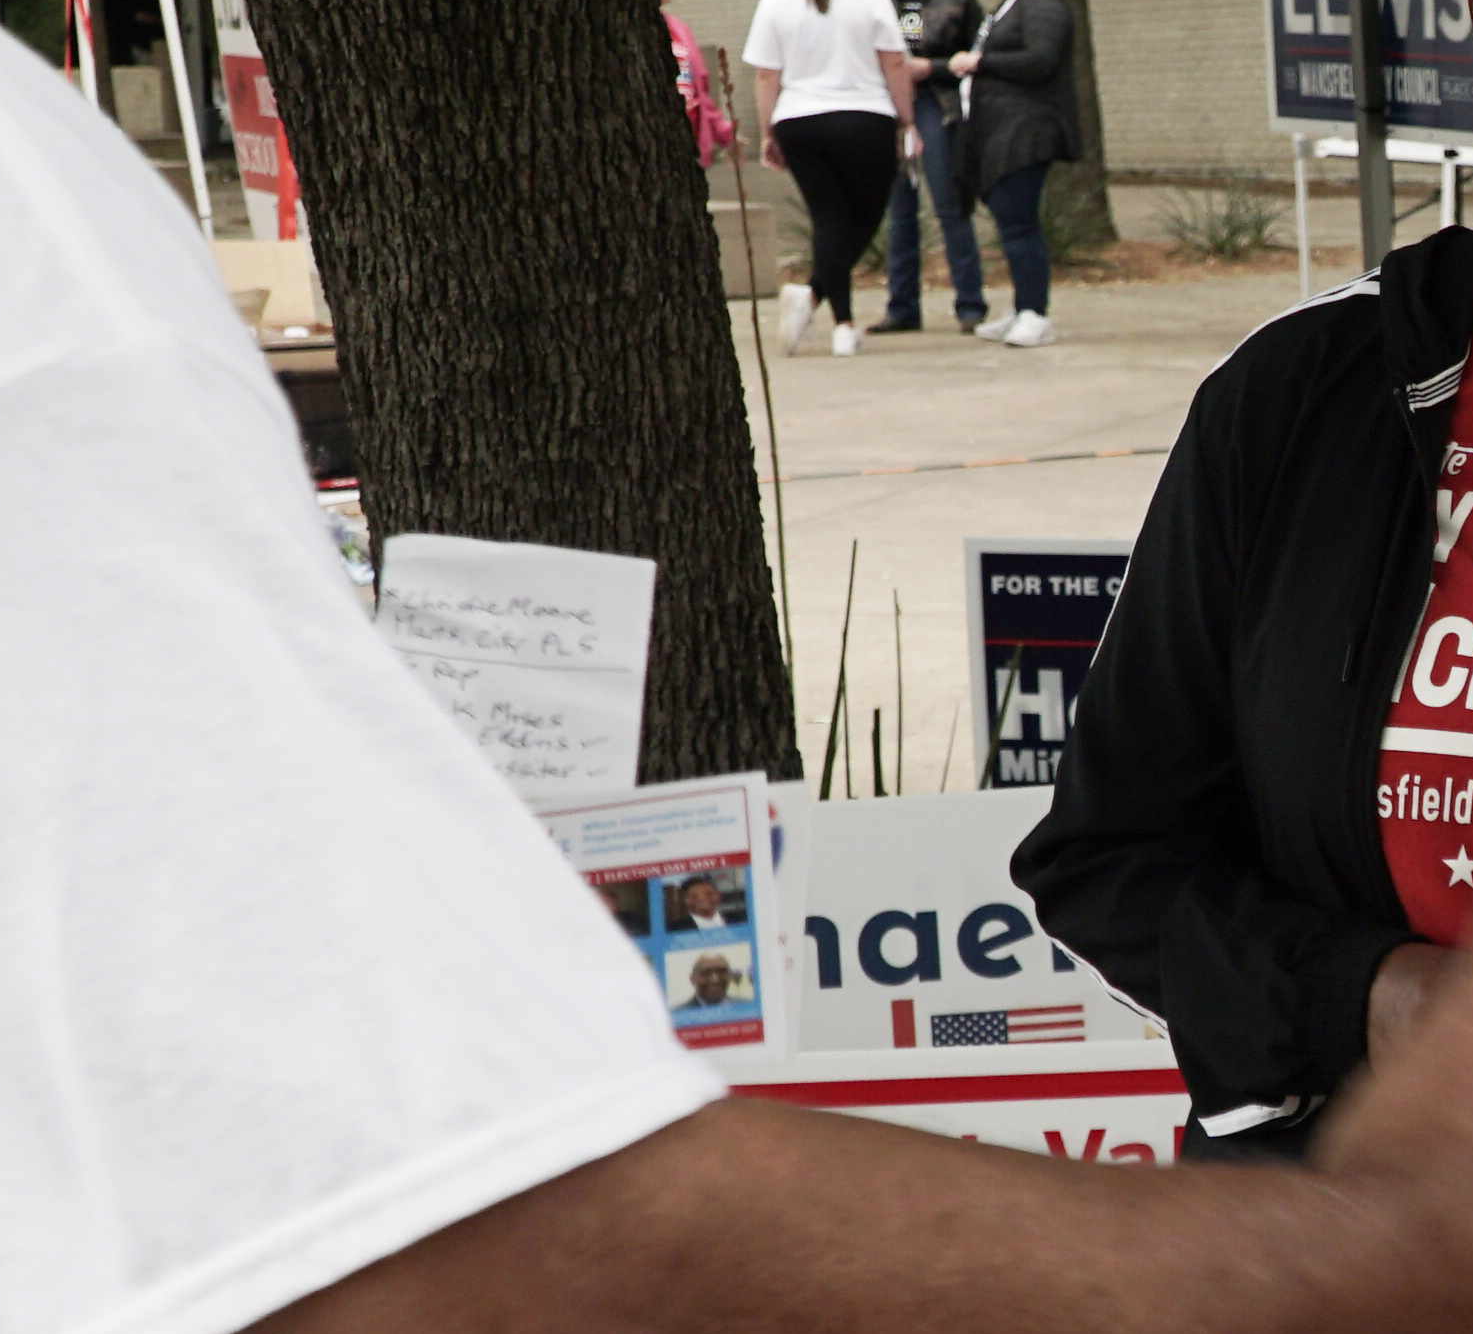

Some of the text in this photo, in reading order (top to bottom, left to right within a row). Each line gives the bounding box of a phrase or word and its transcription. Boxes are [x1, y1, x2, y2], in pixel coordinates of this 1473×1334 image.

[990, 574, 1125, 598] FOR THE C
